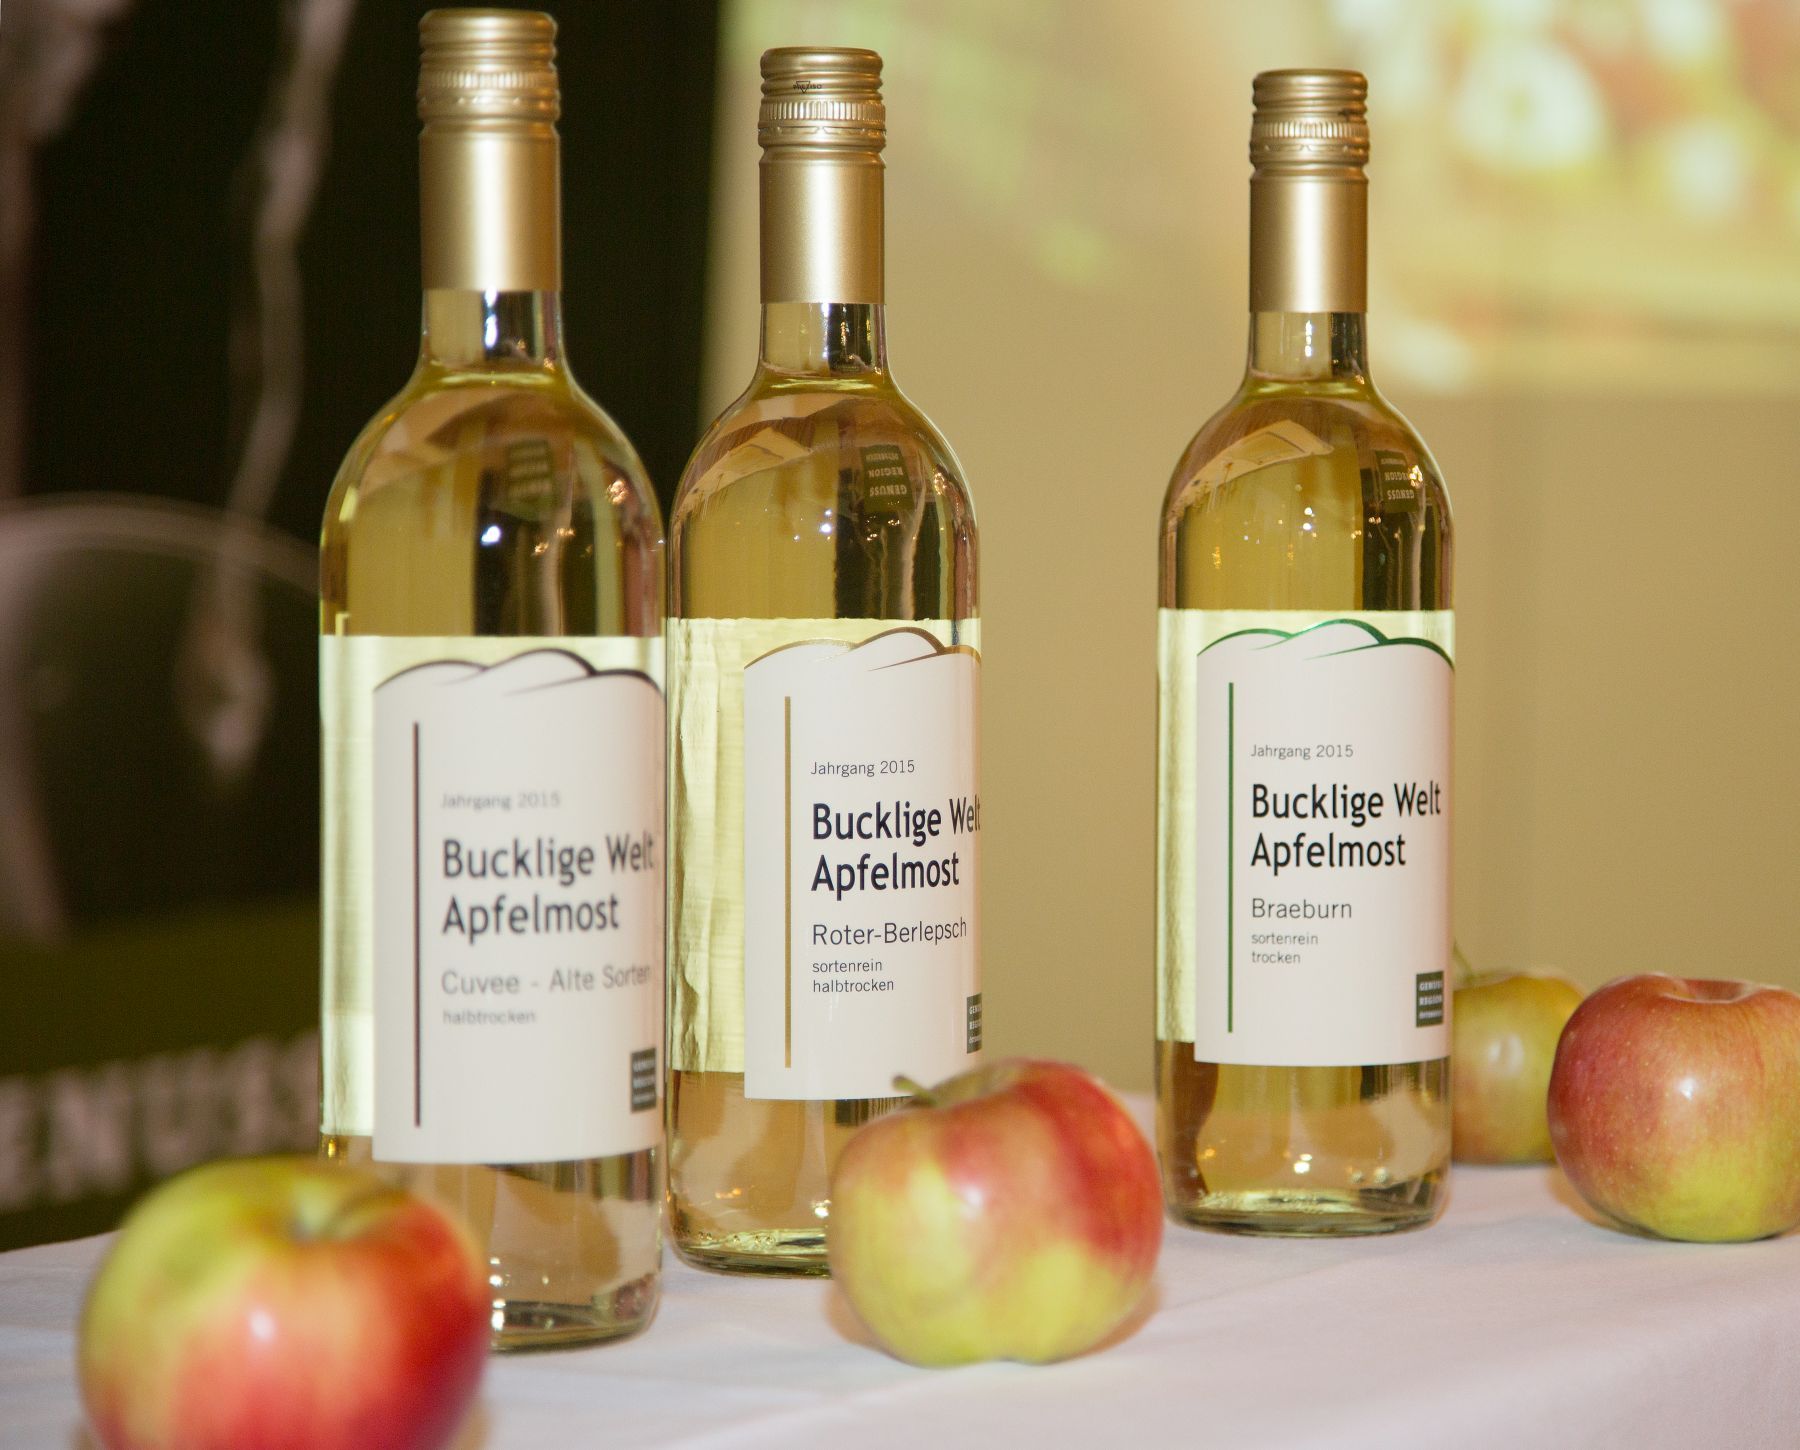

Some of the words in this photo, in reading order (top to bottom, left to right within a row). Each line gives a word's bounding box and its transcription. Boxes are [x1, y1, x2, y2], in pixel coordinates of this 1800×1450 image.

[1250, 744, 1311, 761] Jahrgang
[1315, 744, 1354, 758] 2015
[810, 761, 875, 778] Jahrgang
[879, 759, 915, 774] 2015
[441, 792, 512, 811] Jahrgang
[517, 790, 562, 808] 2015
[1252, 783, 1383, 828] Bucklige
[1393, 780, 1441, 817] Welt
[813, 800, 942, 847] Bucklige
[948, 794, 981, 835] Welt
[442, 837, 595, 888] Bucklige
[605, 833, 655, 872] Welt
[1250, 832, 1406, 876] Apfelmost
[810, 851, 960, 901] Apfelmost
[1251, 897, 1352, 919] Braeburn
[441, 894, 620, 946] Apfelmost
[812, 916, 967, 946] Roter-Berlepsch
[1251, 932, 1319, 946] sortenrein
[812, 958, 883, 973] sortenrein
[1251, 950, 1301, 964] trocken
[441, 969, 521, 995] Cuvee
[549, 967, 595, 992] Alte
[812, 978, 894, 993] halbtrocken
[442, 1008, 537, 1025] halbtrocken
